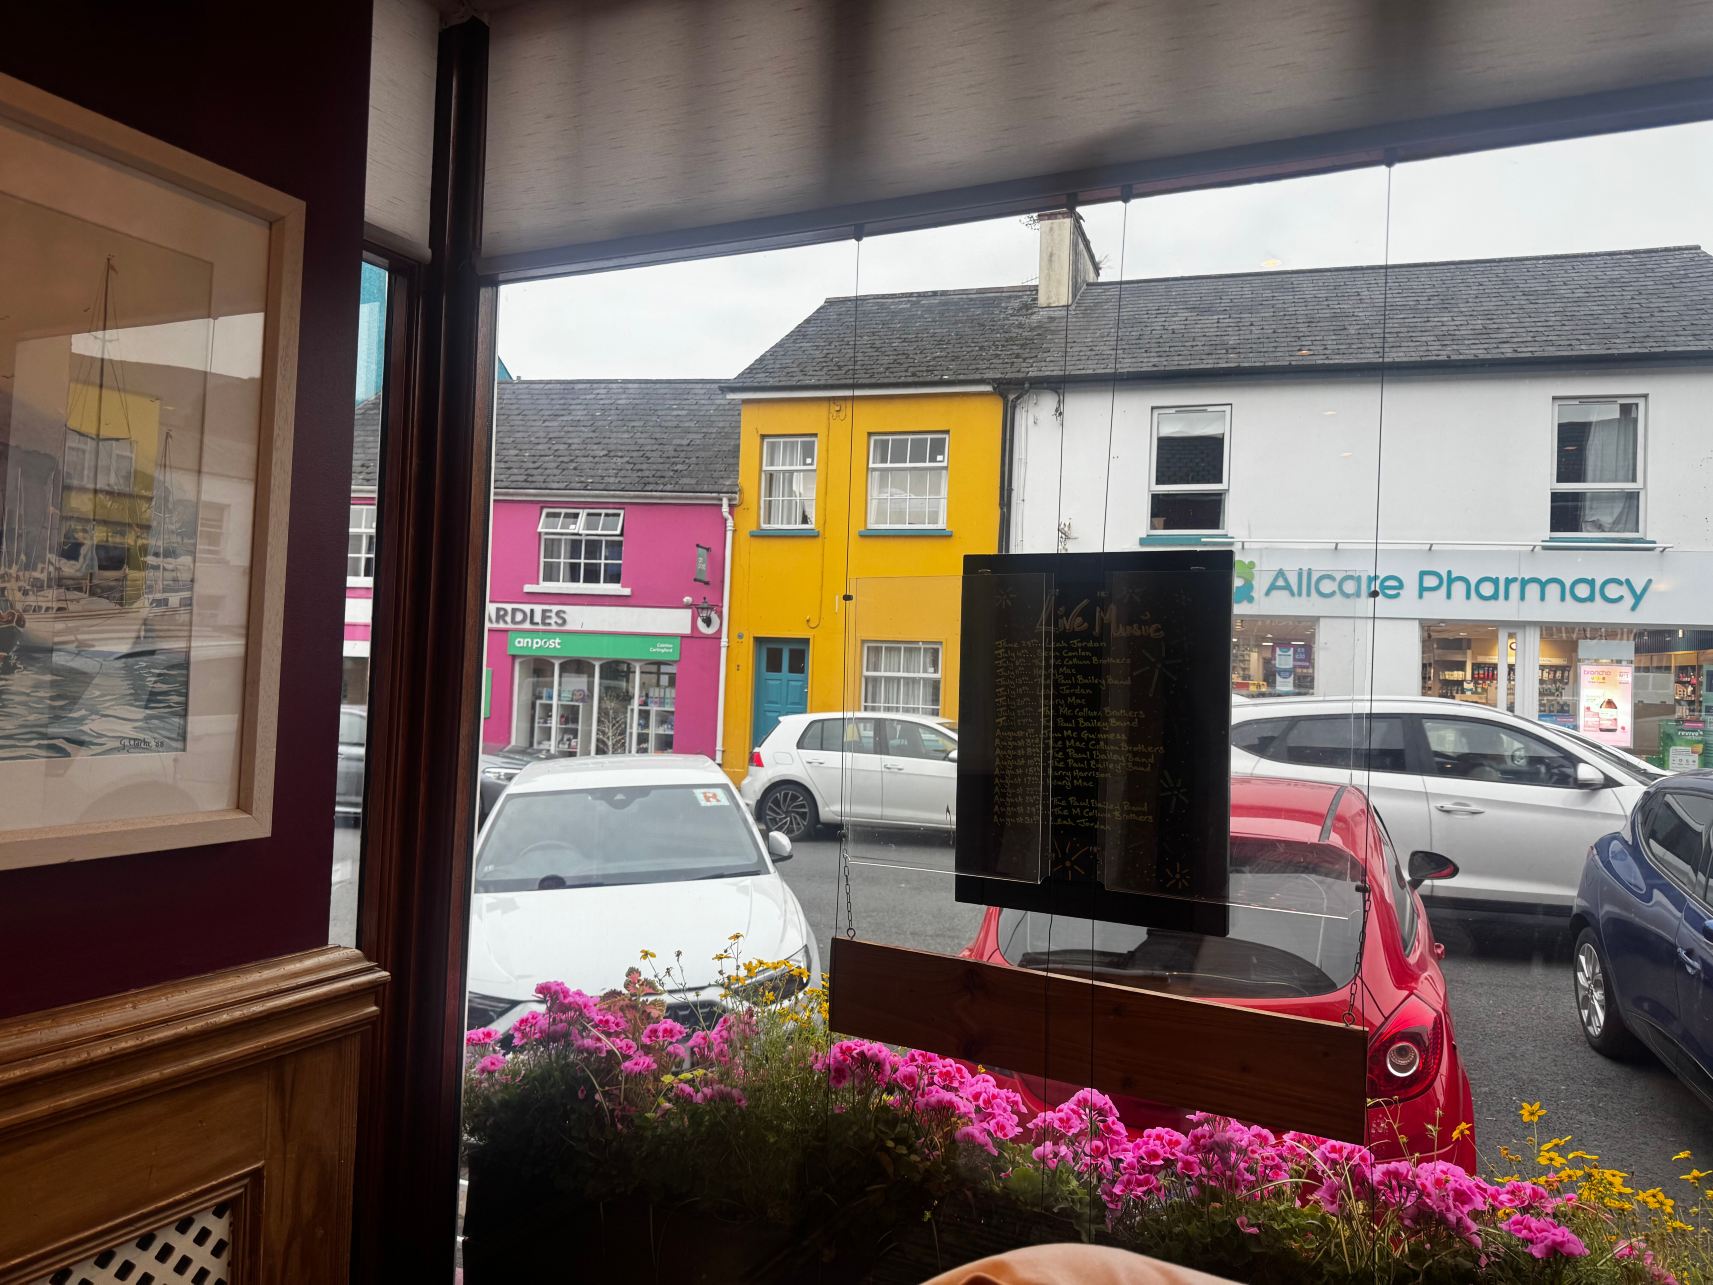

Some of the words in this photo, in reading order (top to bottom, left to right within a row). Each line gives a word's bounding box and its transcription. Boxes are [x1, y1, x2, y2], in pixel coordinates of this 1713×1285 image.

[1264, 568, 1404, 600] Allcare
[1418, 570, 1653, 612] Pharmacy
[1034, 594, 1089, 634] Live
[1070, 639, 1107, 649] Jordan
[1057, 666, 1077, 675] Mac
[1056, 675, 1075, 685] Paul
[1059, 686, 1093, 695] Jordan
[1067, 696, 1087, 705] Mac
[1104, 706, 1145, 718] Brothers
[1056, 717, 1076, 727] Paul
[1121, 743, 1166, 753] Brothers
[1066, 749, 1091, 759] Paul
[1066, 758, 1088, 768] Paul
[1068, 797, 1089, 807] Paul
[1075, 818, 1113, 831] Jordan
